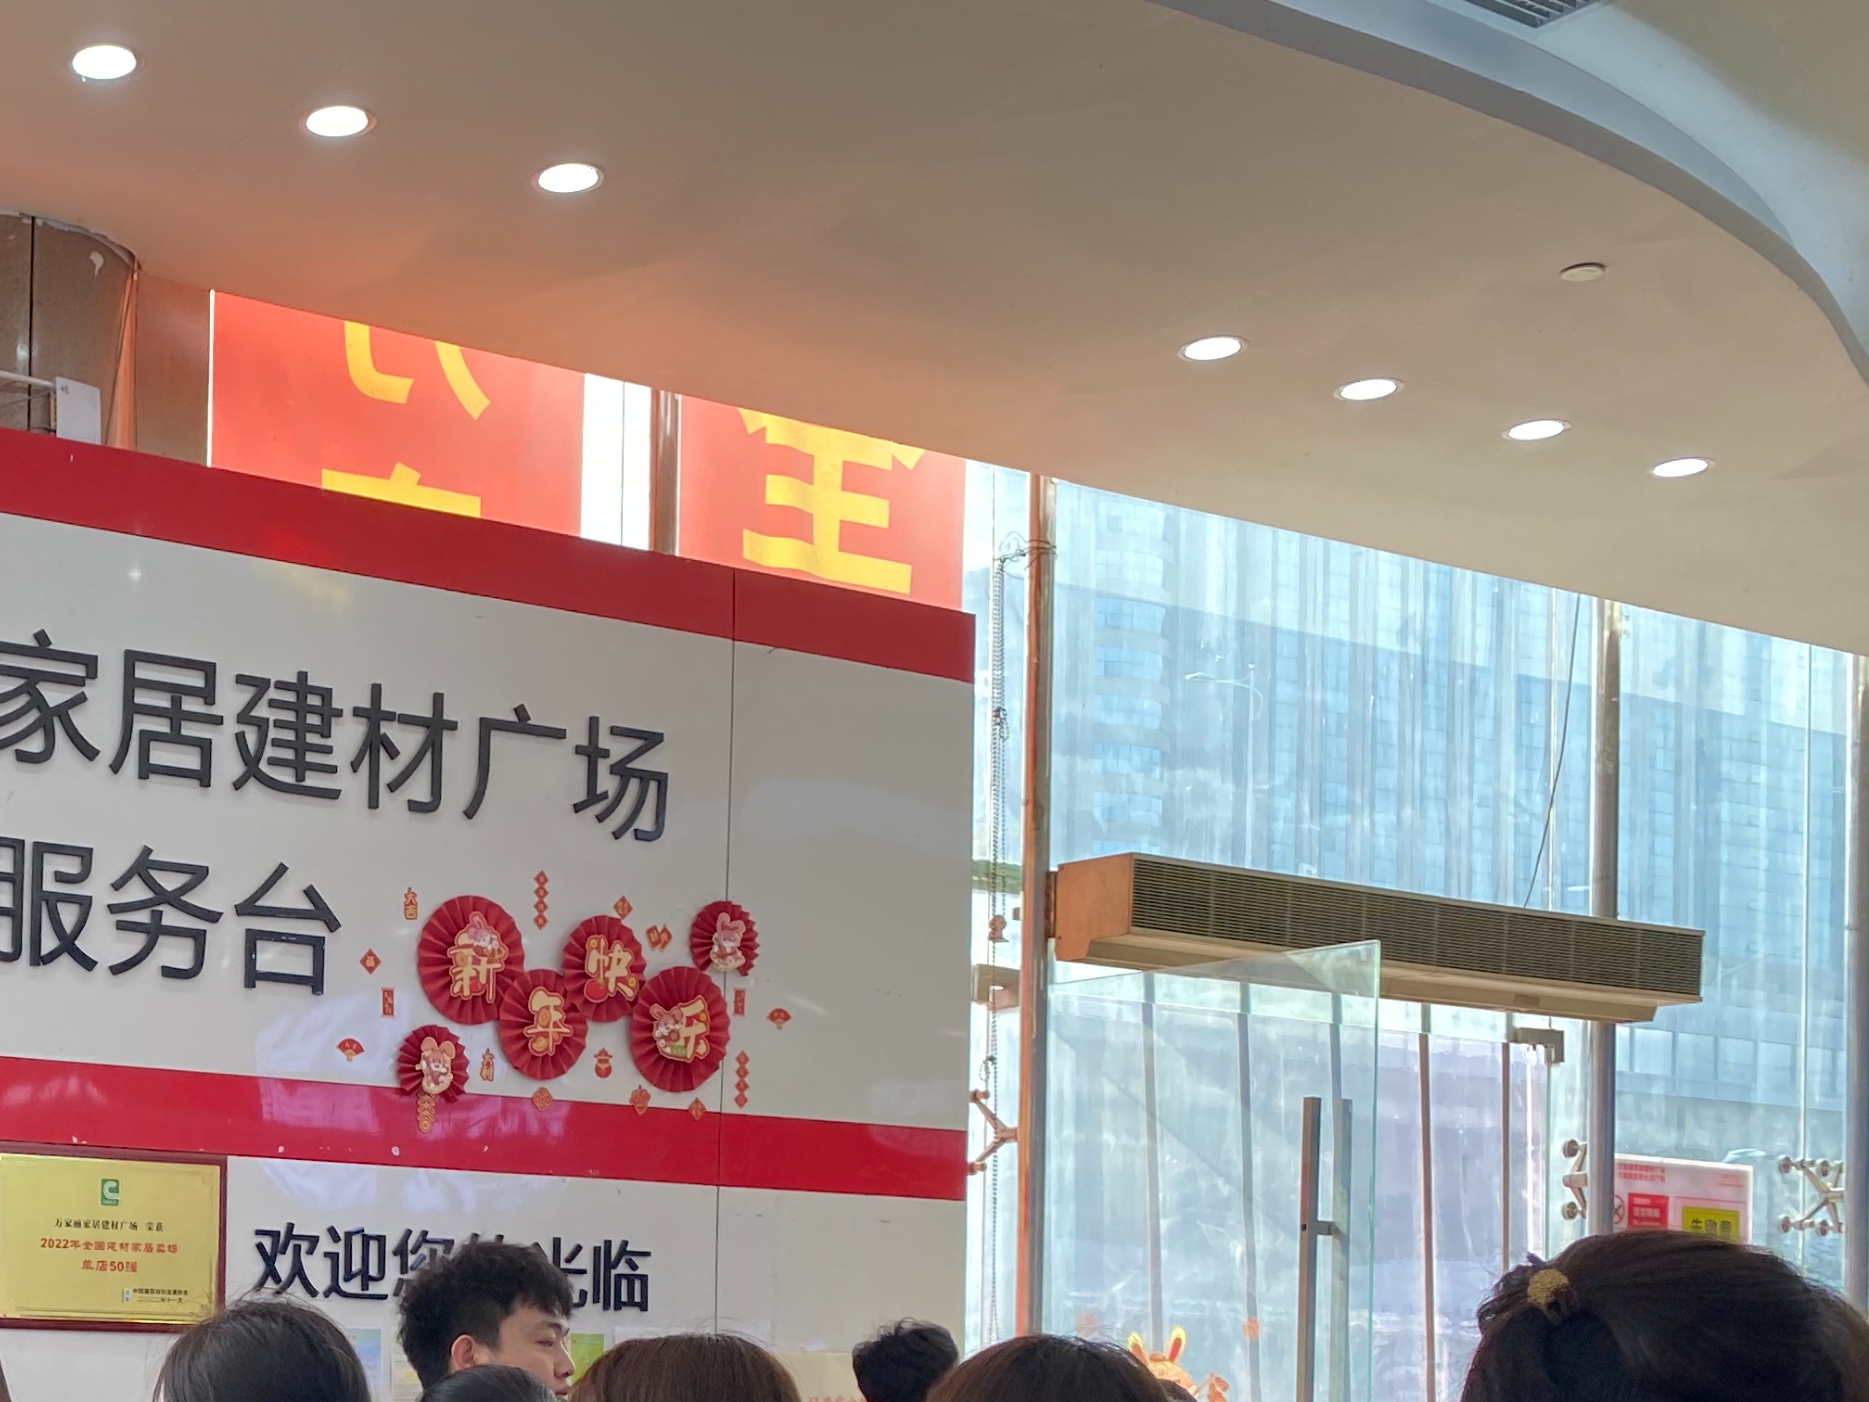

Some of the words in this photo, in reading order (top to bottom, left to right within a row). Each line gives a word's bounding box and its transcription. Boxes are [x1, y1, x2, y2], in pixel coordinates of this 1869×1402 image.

[55, 1218, 138, 1232] 万家丽家居建材广场
[40, 1238, 177, 1253] 2022年全国建材家居卖场
[81, 1259, 138, 1273] 单店50强
[253, 1221, 652, 1312] 欢迎您光临
